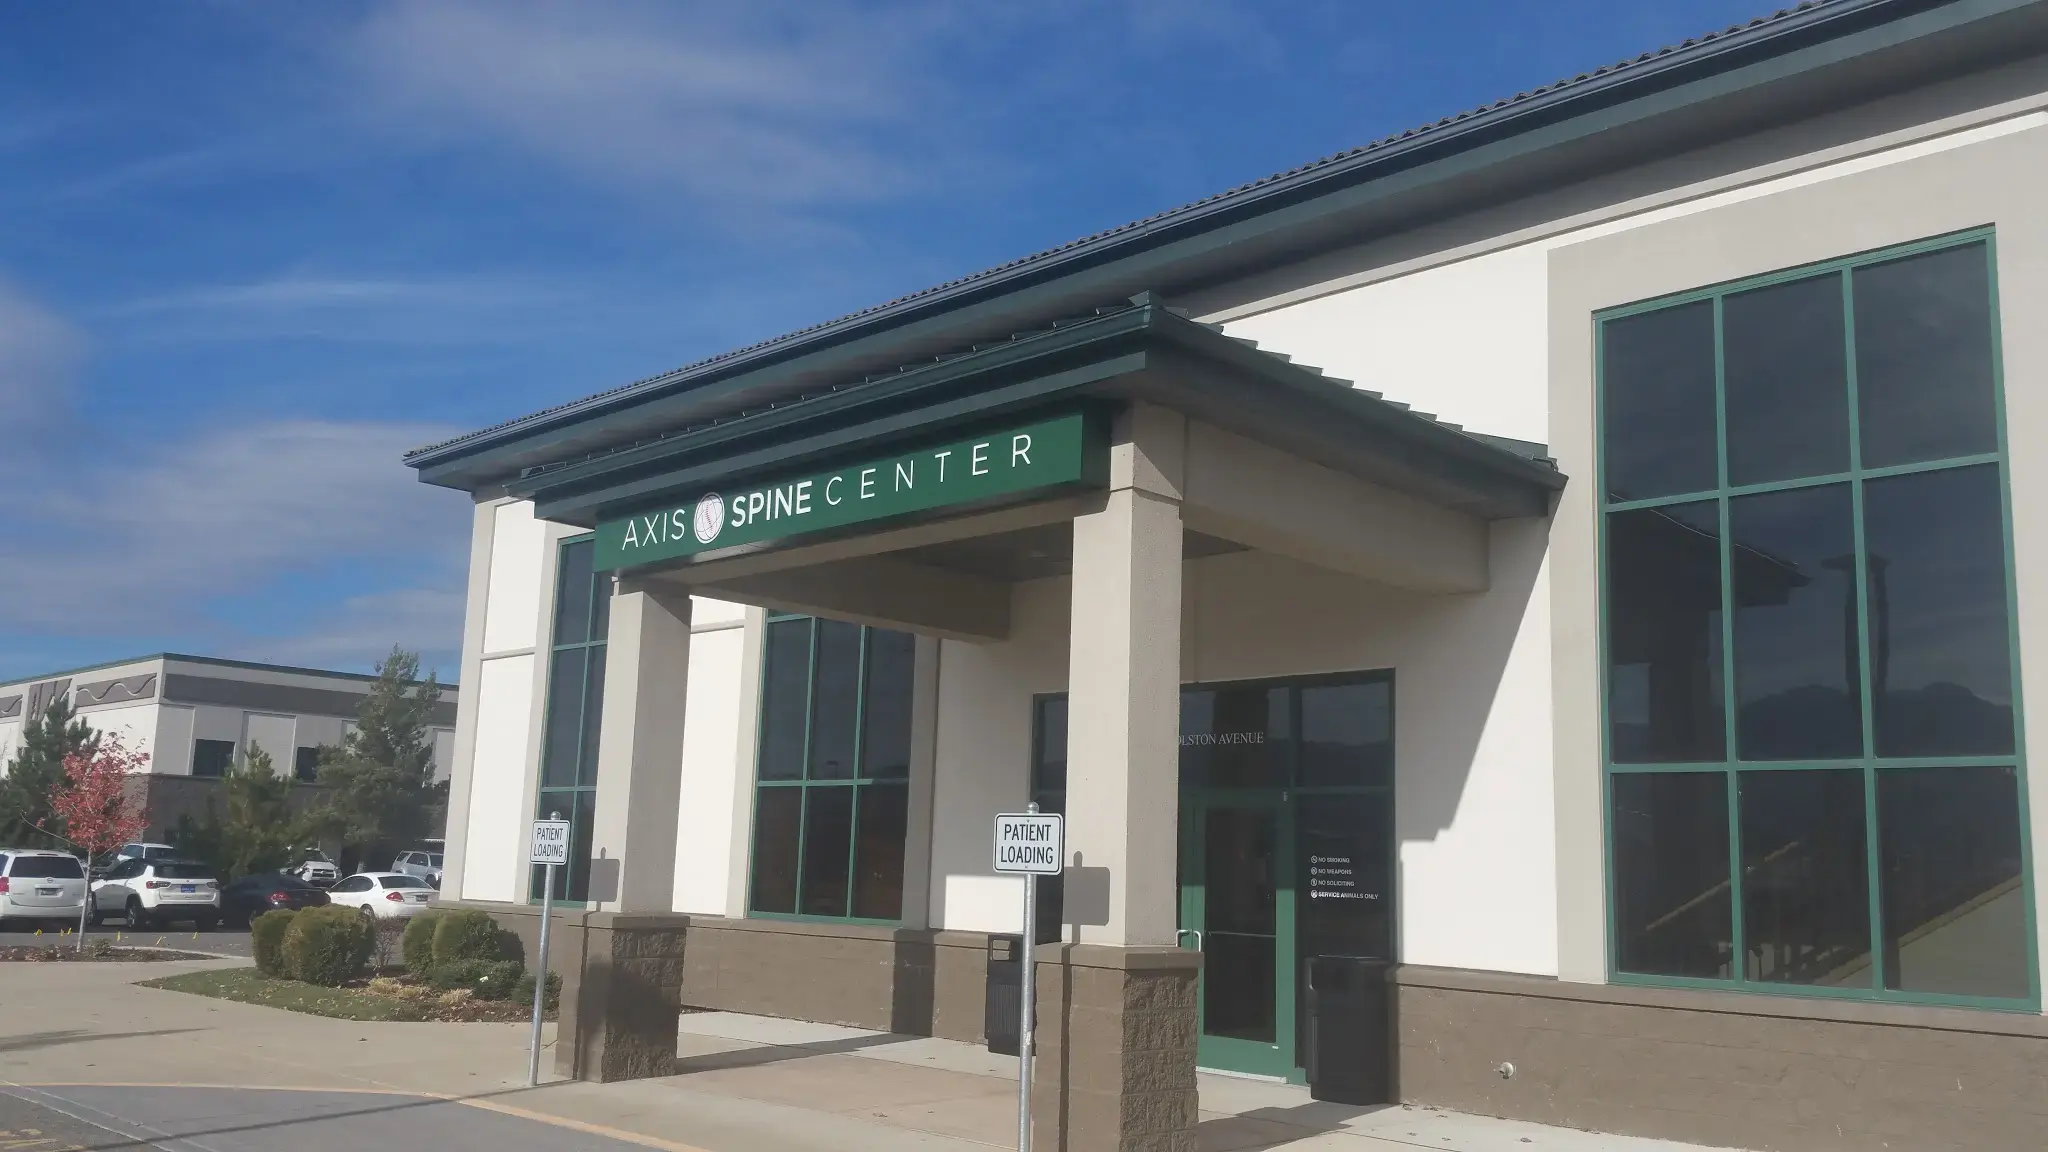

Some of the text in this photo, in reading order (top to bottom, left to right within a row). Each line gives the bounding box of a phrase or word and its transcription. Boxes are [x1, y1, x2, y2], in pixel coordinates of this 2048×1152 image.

[622, 434, 1032, 550] AXIS SPINE CENTER
[1218, 732, 1264, 745] AVENUE
[536, 827, 564, 841] PATIENT
[1004, 823, 1052, 842] PATIENT
[533, 843, 564, 858] LOADING
[1000, 845, 1054, 865] LOADING
